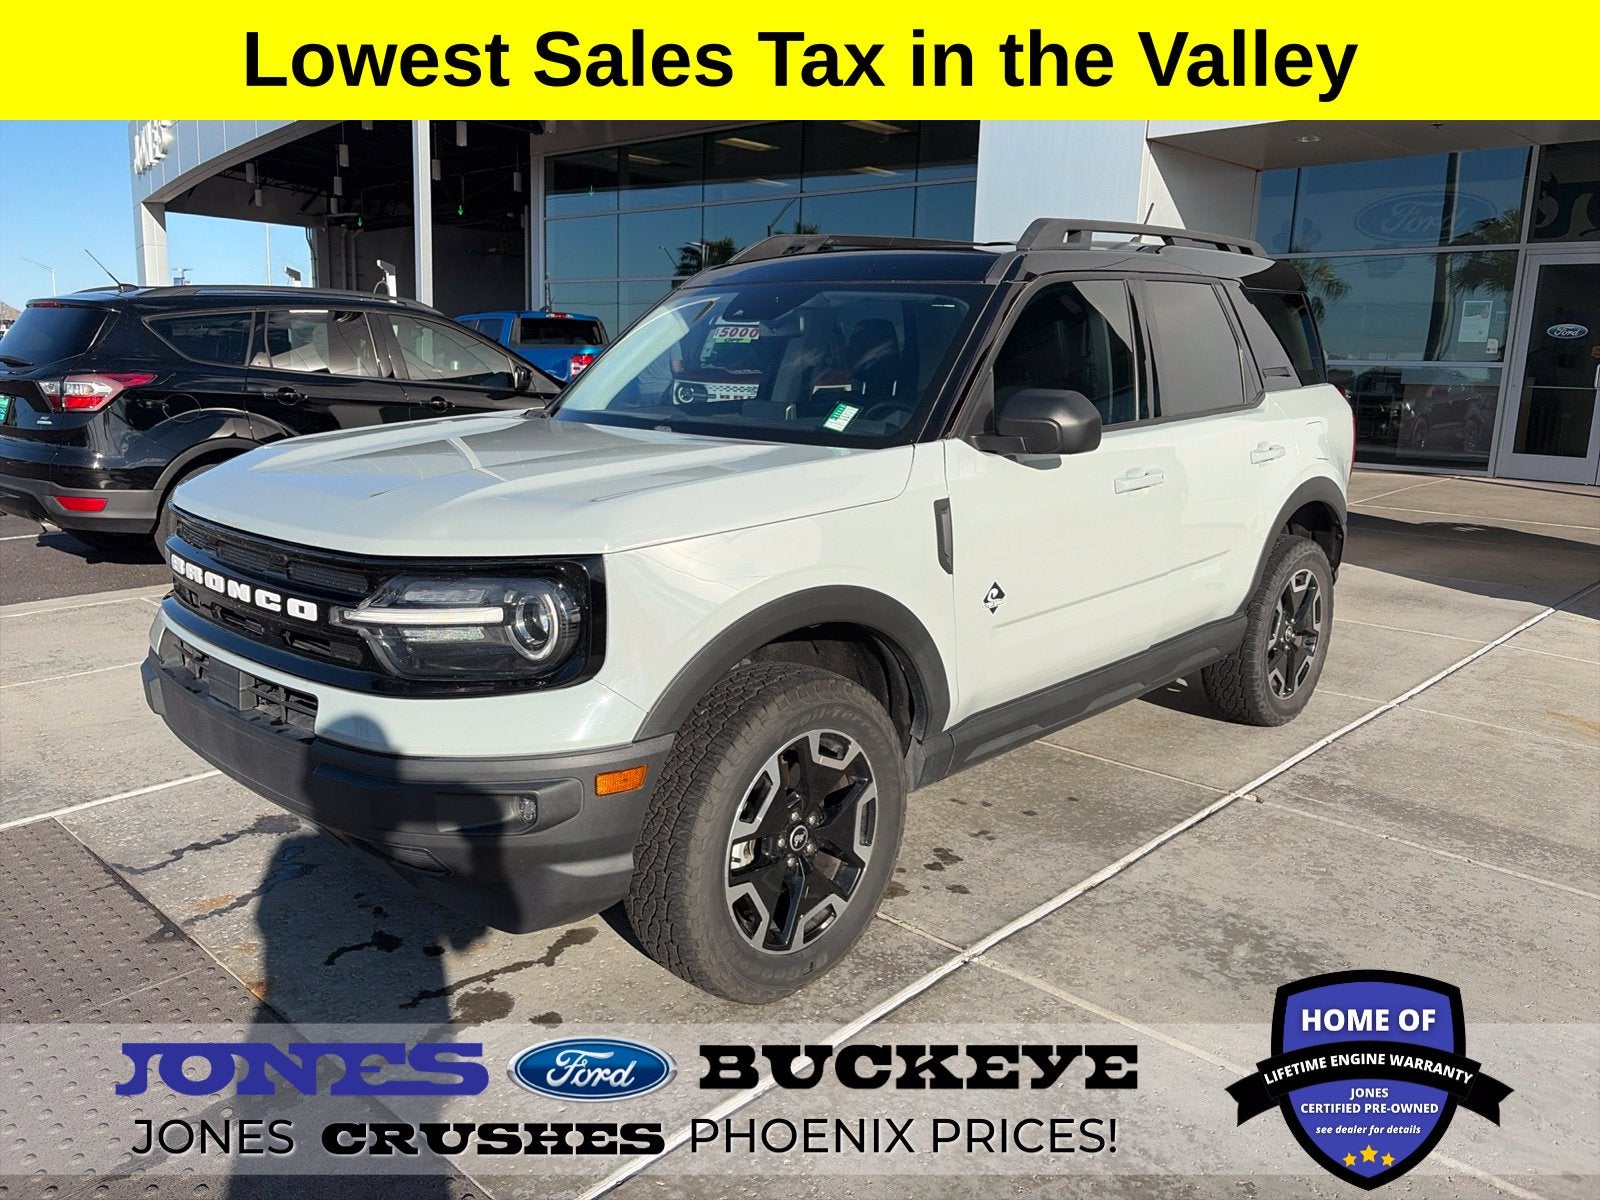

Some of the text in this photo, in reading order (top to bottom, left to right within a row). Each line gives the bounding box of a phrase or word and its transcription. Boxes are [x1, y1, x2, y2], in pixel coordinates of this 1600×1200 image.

[1381, 201, 1467, 234] Ford
[1553, 325, 1580, 337] Ford
[170, 553, 319, 622] BRONCO
